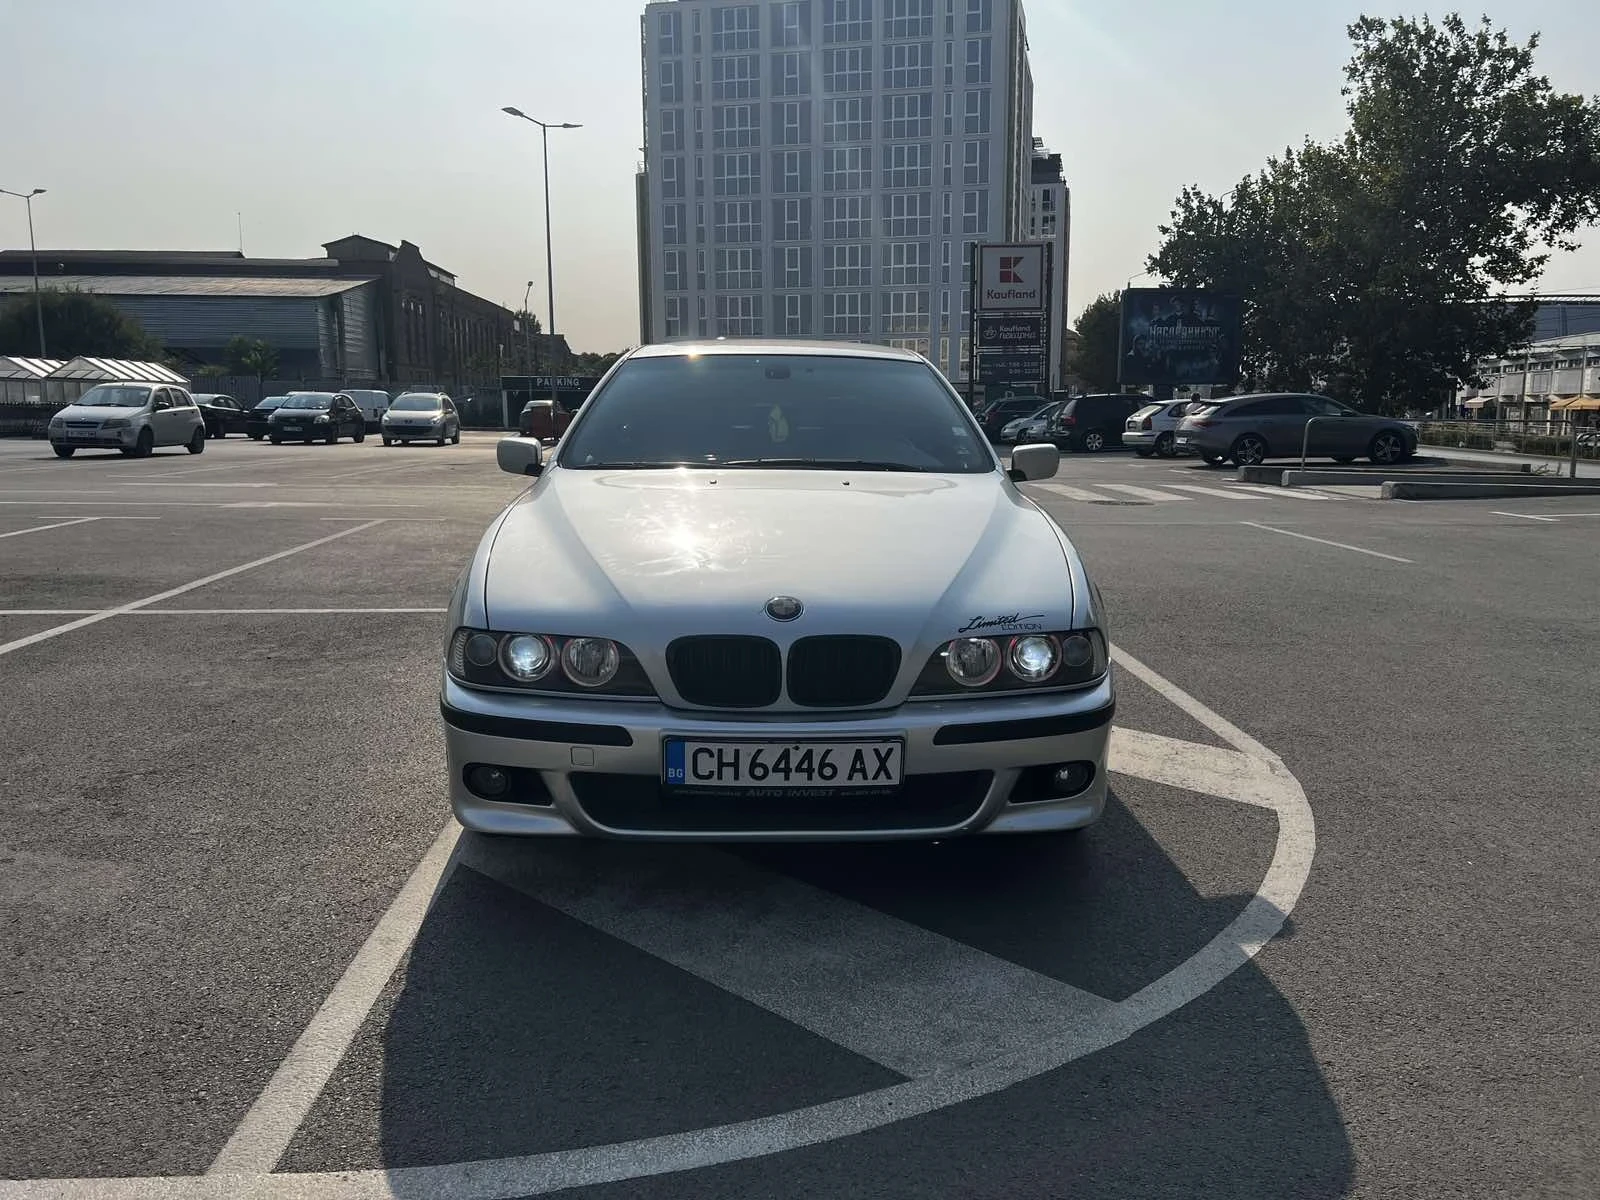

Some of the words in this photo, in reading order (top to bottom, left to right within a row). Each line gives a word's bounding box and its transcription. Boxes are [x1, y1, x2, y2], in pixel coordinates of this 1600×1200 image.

[987, 289, 1036, 300] Kaufland
[958, 612, 1045, 634] Limited
[1001, 623, 1042, 631] EDITION
[691, 747, 740, 781] CH
[749, 747, 839, 781] 6446
[847, 747, 895, 781] AX
[668, 767, 684, 778] BG
[746, 788, 784, 797] AUTO
[788, 788, 835, 797] INVEST
